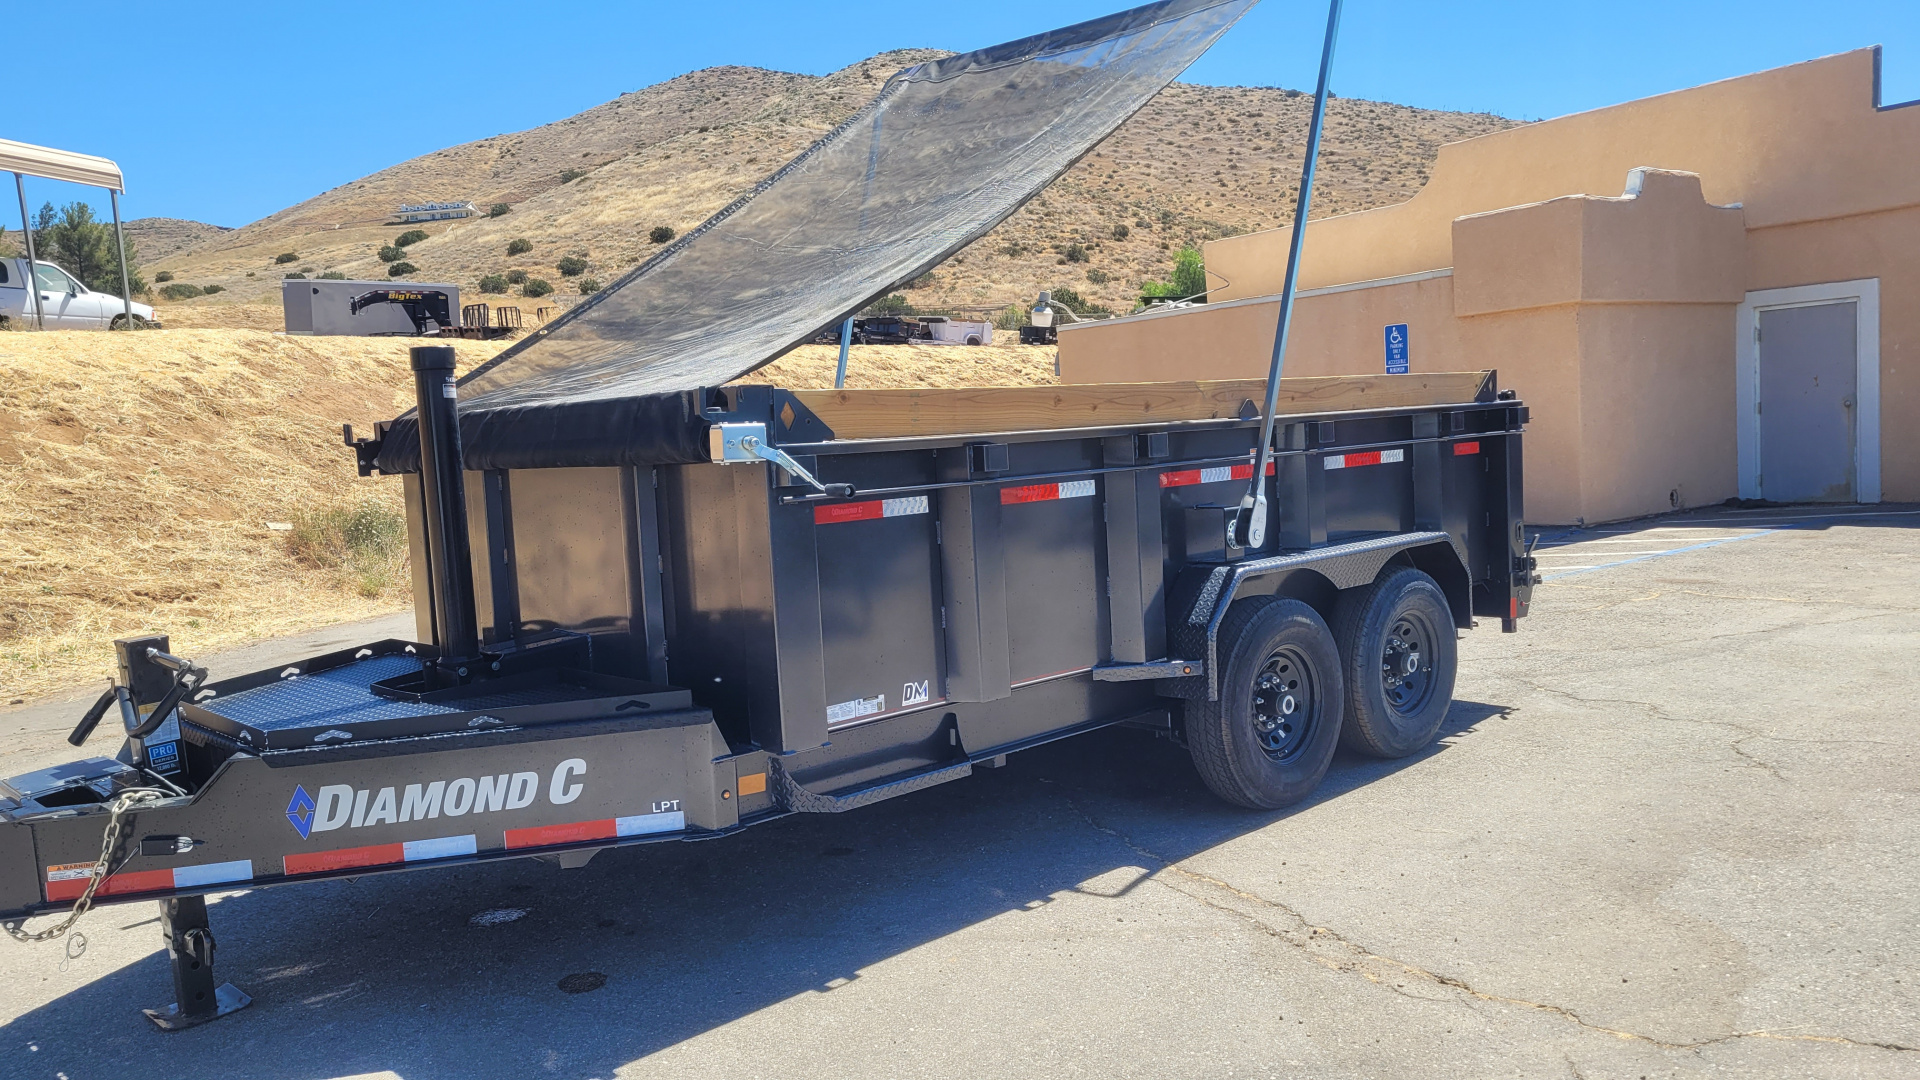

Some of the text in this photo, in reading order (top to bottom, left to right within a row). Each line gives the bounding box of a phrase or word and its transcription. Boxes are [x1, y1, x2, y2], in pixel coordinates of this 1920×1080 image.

[152, 745, 173, 757] PRO
[311, 758, 587, 833] DIAMOND C
[652, 800, 680, 813] LPT
